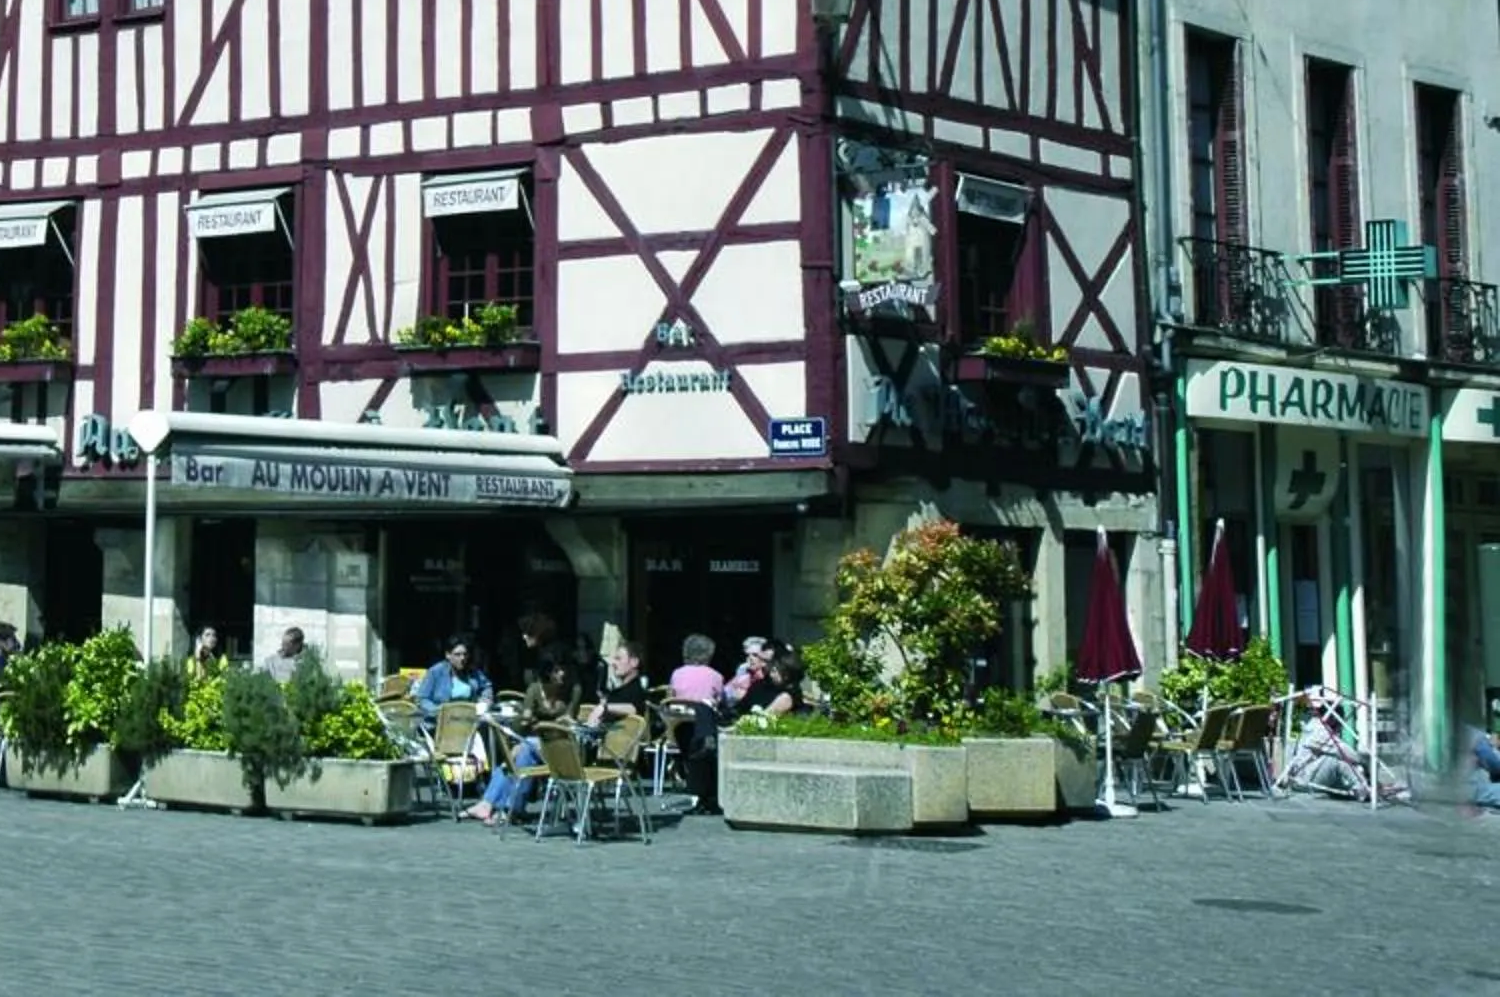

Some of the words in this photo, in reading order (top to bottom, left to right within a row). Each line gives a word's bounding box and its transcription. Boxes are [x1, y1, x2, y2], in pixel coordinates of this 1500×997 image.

[434, 186, 506, 206] RESTAURANT
[198, 210, 262, 229] RESTAURANT
[859, 280, 930, 309] RESTAURANT
[621, 369, 733, 394] Restaurant
[1219, 367, 1422, 431] PHARMACIE
[781, 422, 813, 436] PLACE
[186, 456, 224, 481] Bar
[252, 460, 280, 487] AU
[291, 463, 371, 492] MOULIN
[376, 470, 395, 495] A
[404, 470, 450, 497] VENT
[476, 476, 556, 497] RESTAURANT
